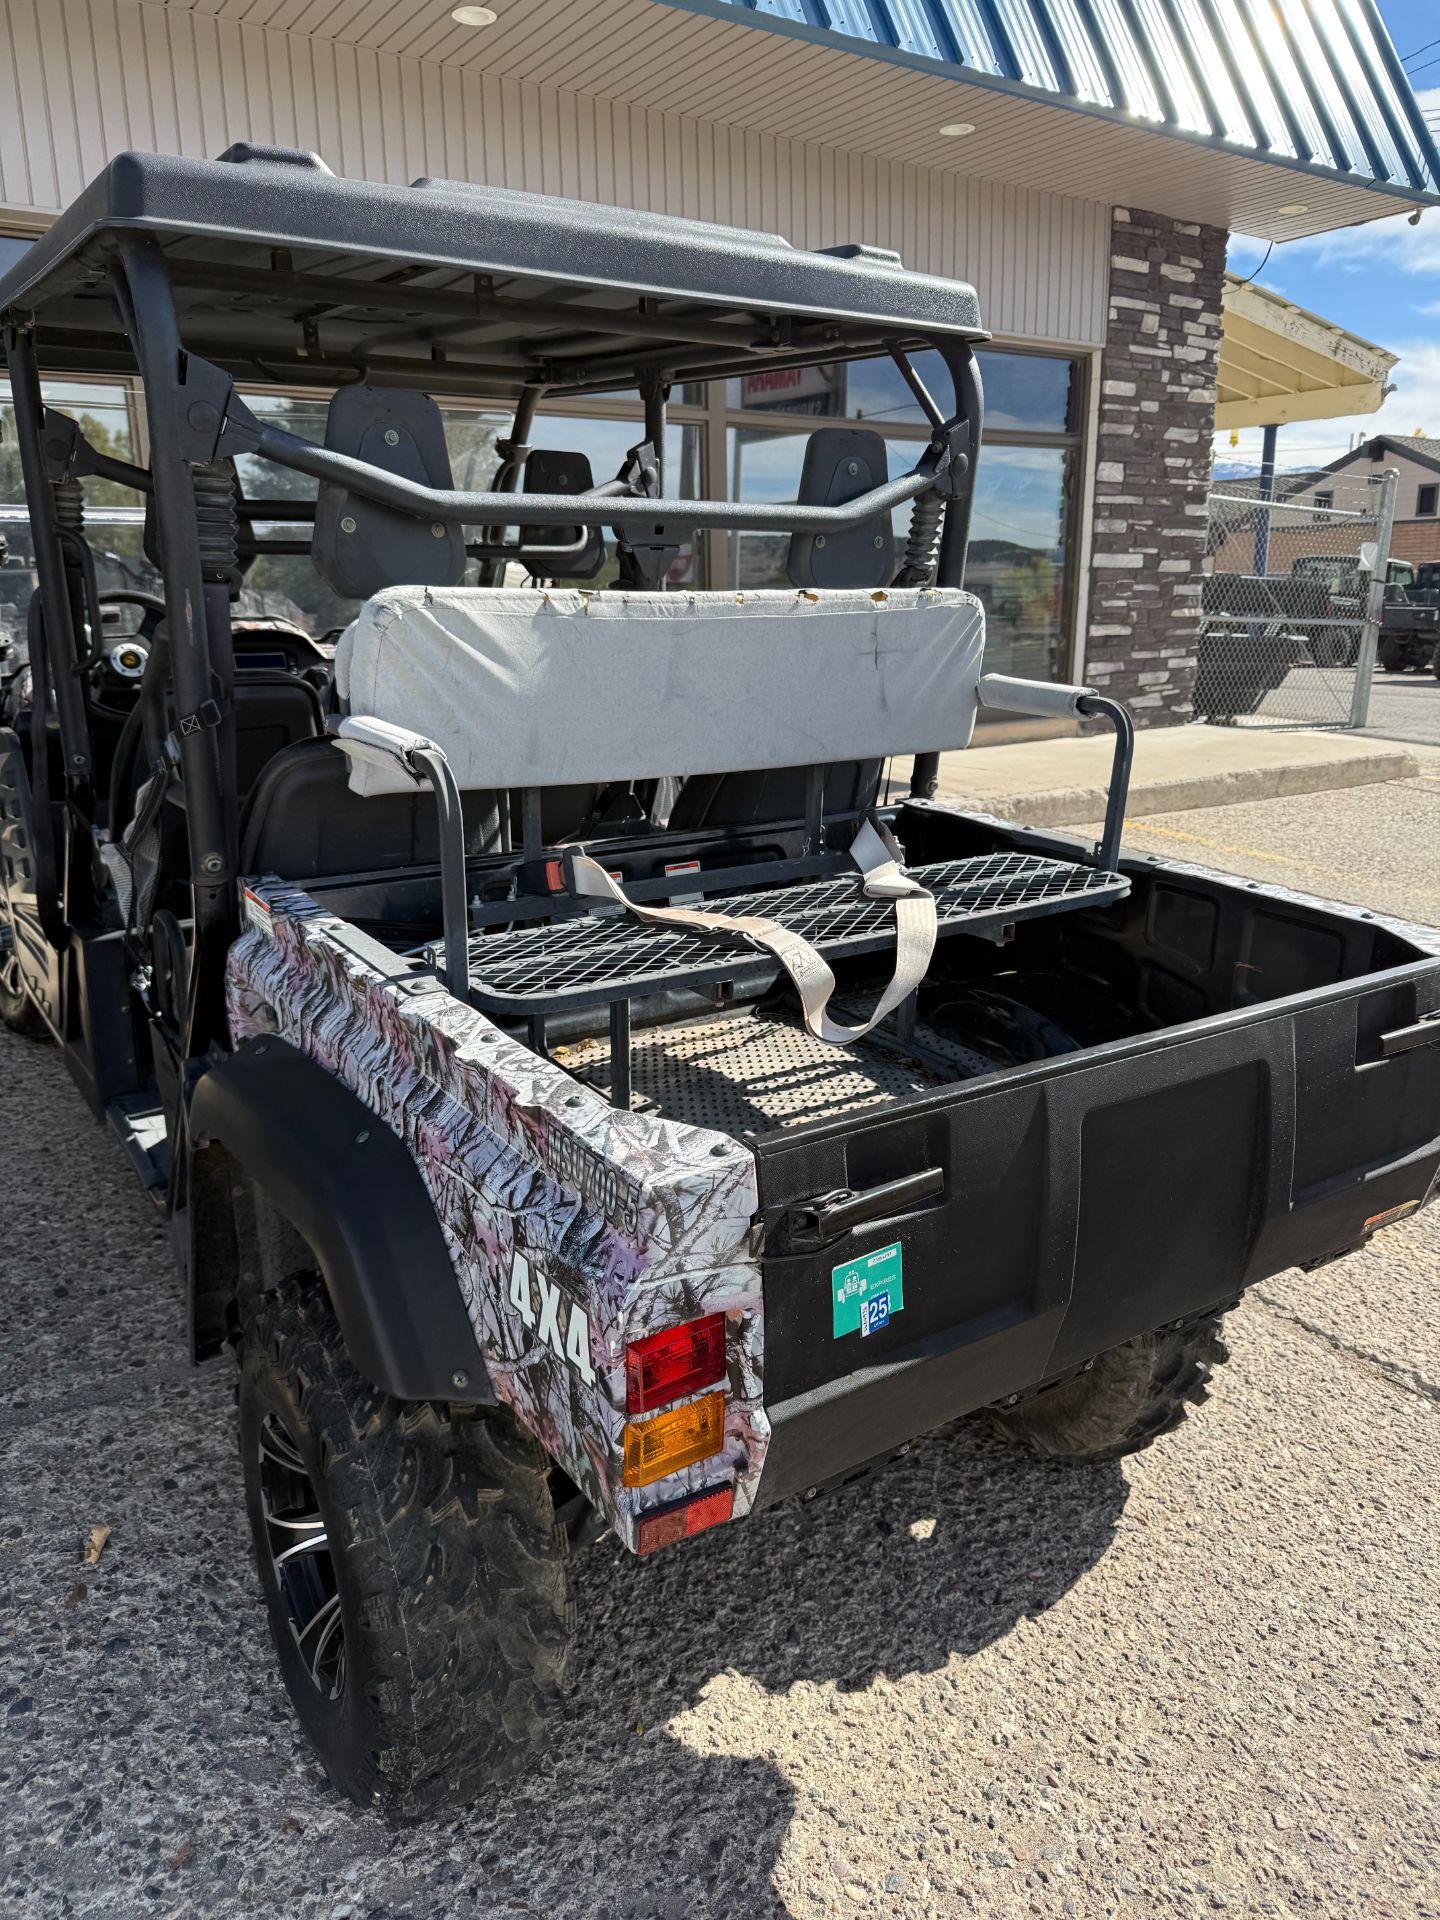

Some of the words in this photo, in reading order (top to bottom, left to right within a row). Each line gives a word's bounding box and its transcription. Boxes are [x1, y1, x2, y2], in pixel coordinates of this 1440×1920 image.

[870, 1275, 896, 1290] EXPIRES
[510, 1250, 596, 1387] 4X4
[869, 1297, 888, 1324] 25
